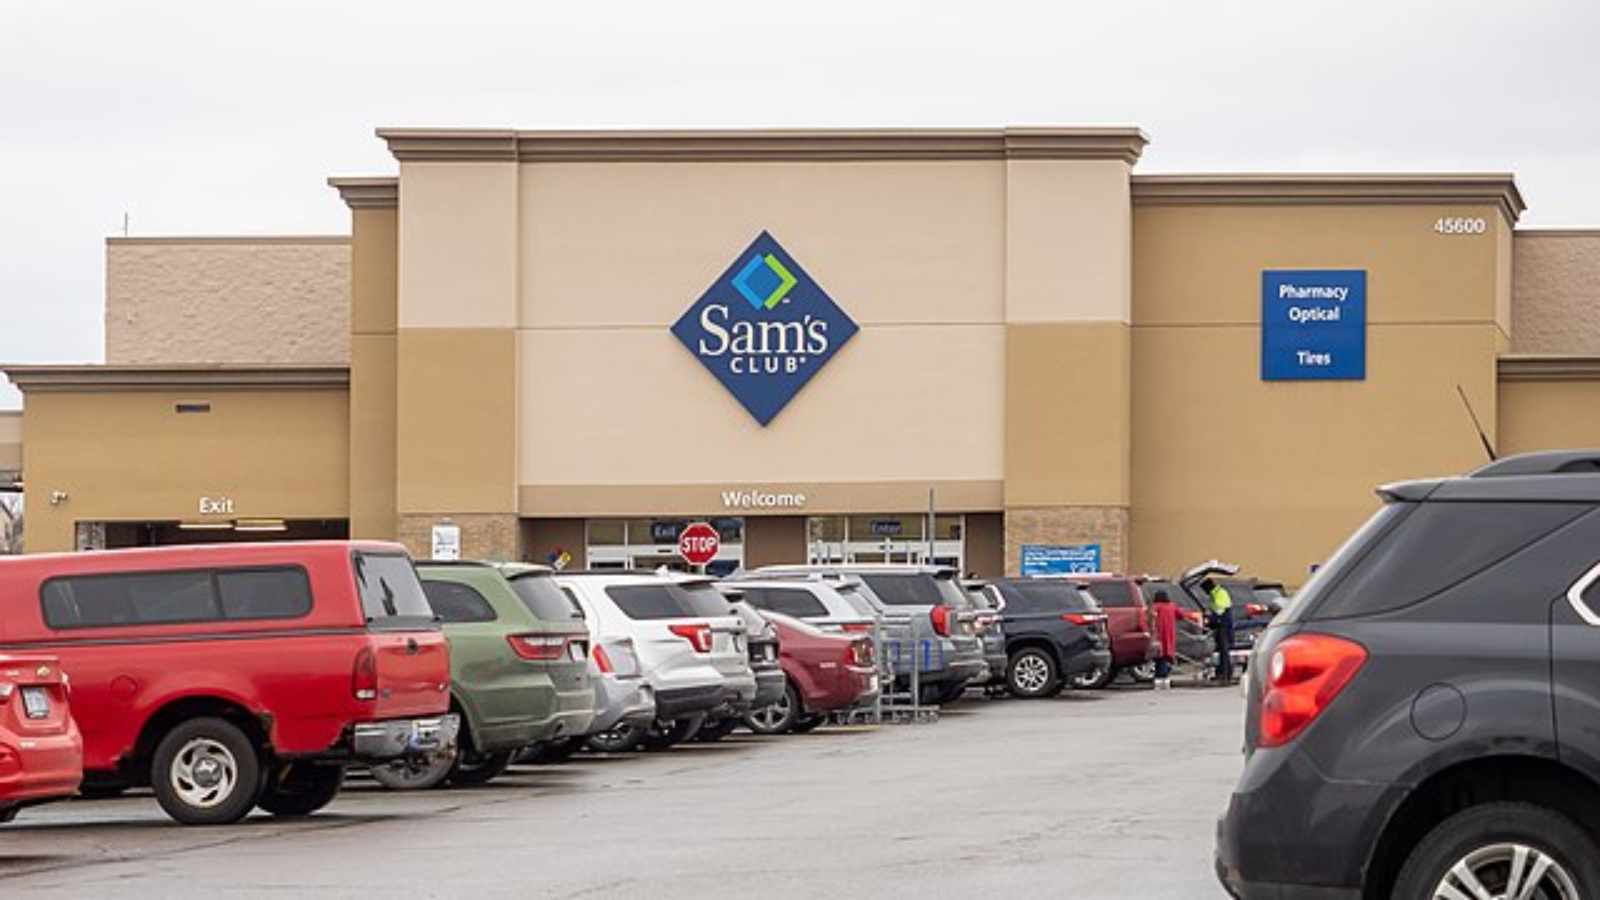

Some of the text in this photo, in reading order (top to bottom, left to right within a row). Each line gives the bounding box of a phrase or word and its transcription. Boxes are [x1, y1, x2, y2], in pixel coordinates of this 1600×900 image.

[1434, 218, 1487, 234] 45600
[1279, 284, 1349, 302] Pharmacy
[1289, 306, 1341, 323] Optical
[698, 303, 829, 356] Sam's
[1296, 350, 1332, 366] Tires
[199, 496, 235, 514] Exit
[722, 489, 806, 507] Welcome
[682, 536, 717, 553] STOP
